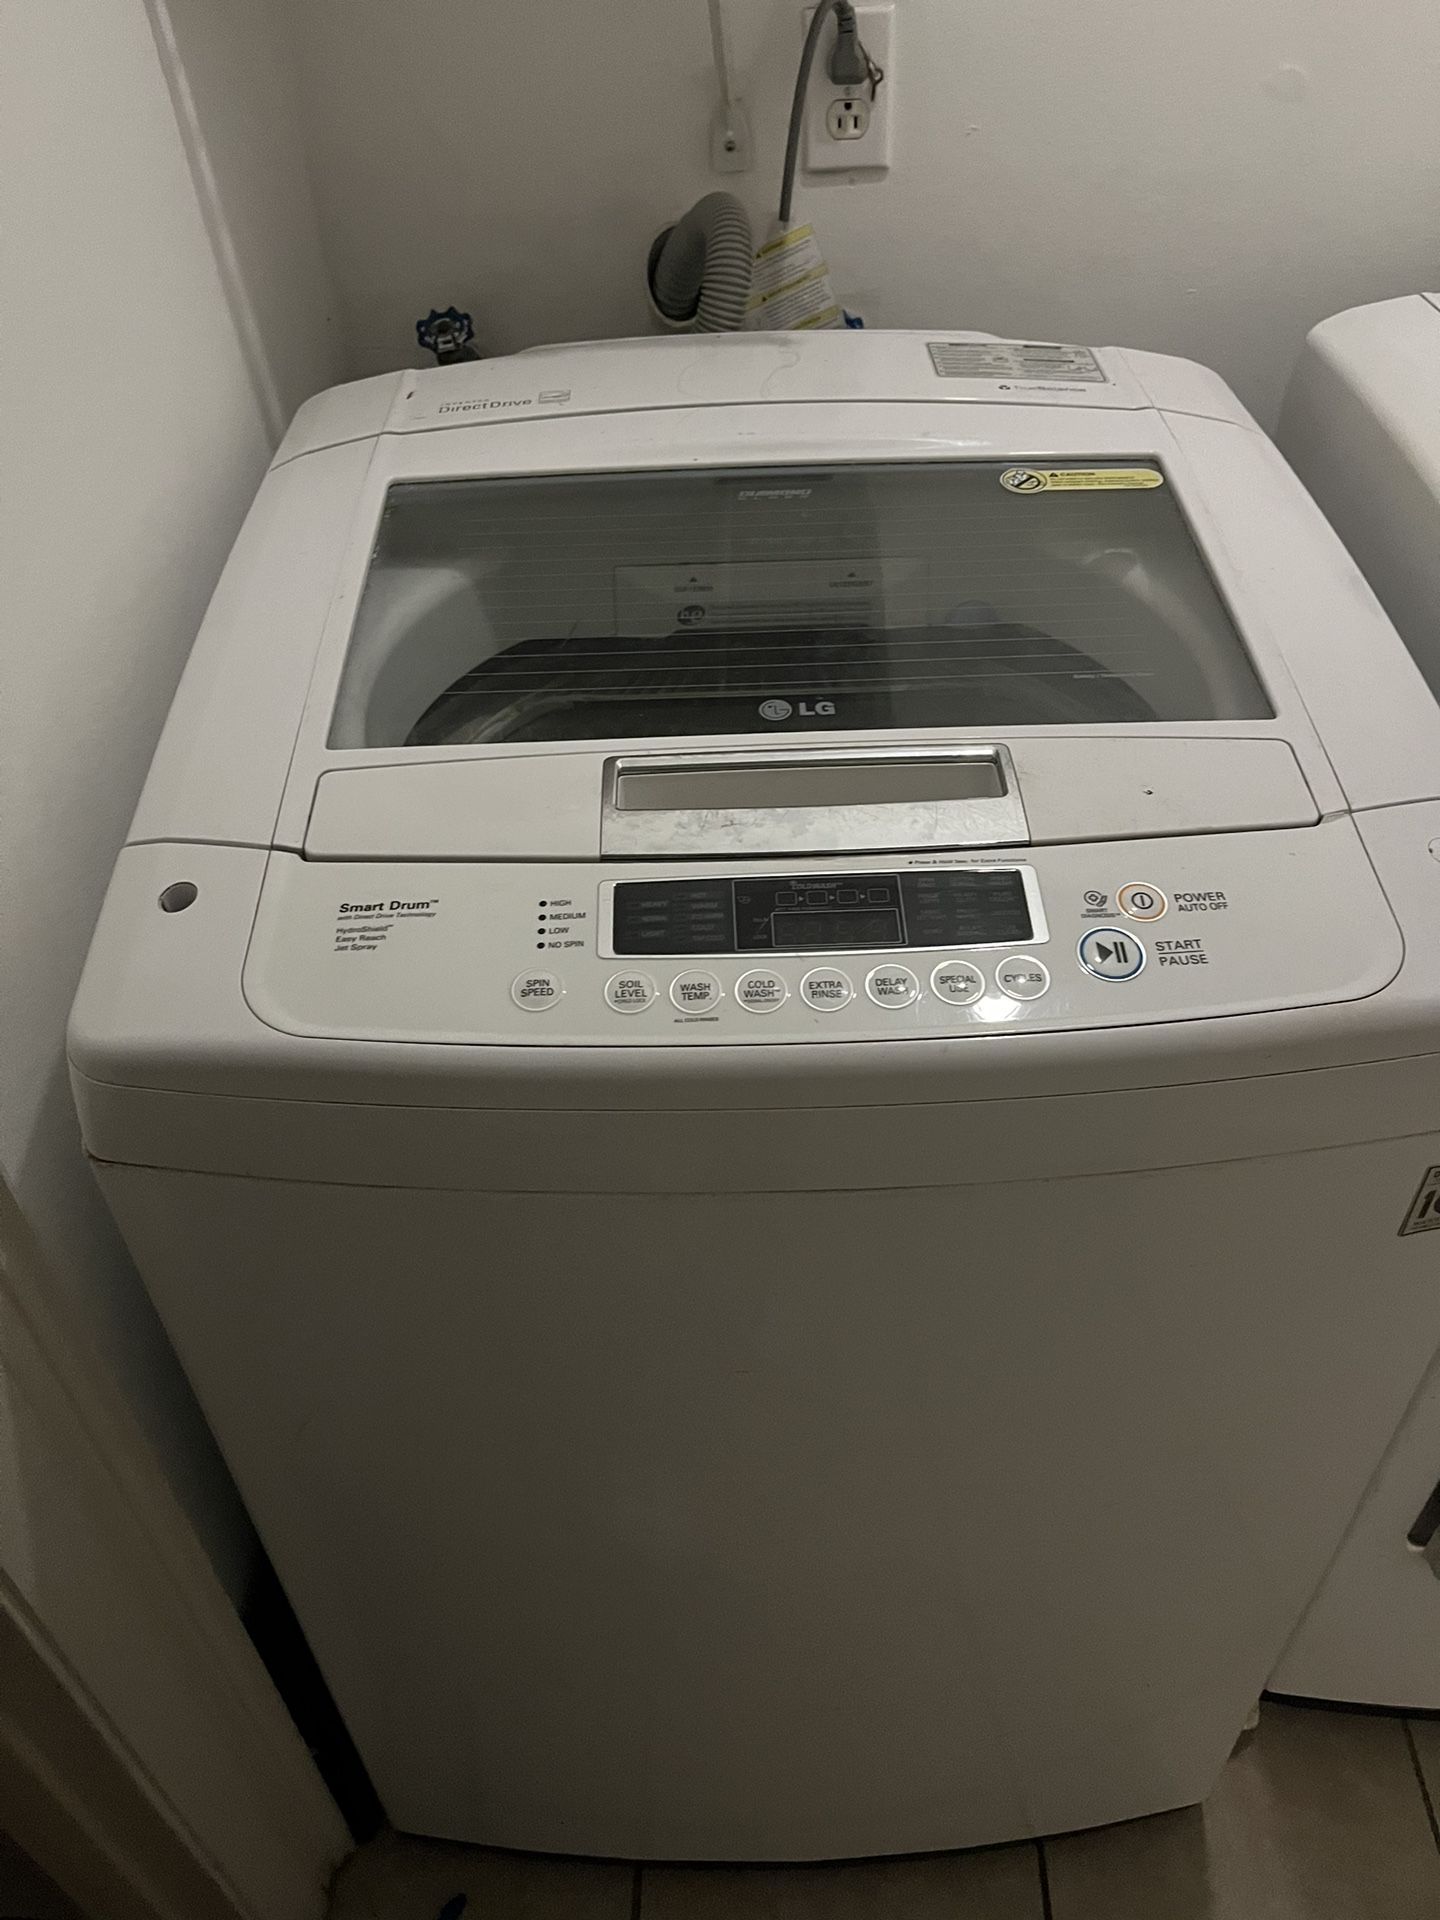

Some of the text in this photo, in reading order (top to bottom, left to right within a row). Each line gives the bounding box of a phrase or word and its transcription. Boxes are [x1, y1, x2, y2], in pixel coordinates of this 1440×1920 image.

[799, 701, 836, 716] LG
[1174, 891, 1226, 903] POWER
[339, 903, 385, 913] Smart
[1178, 902, 1229, 912] AUTO OFF
[549, 912, 586, 920] MEDIUM
[549, 927, 570, 935] LOW
[350, 943, 378, 952] Spray
[548, 940, 585, 949] NO SPIN
[1155, 939, 1202, 951] START
[1159, 954, 1209, 966] PAUSE
[526, 979, 550, 988] SPIN
[875, 978, 907, 987] DELAY
[939, 975, 976, 984] SPECIAL
[618, 980, 643, 989] SOIL
[680, 982, 711, 992] WASH
[748, 980, 775, 989] COLD
[808, 981, 844, 990] EXTRA
[520, 988, 554, 998] SPEED
[614, 989, 648, 998] LEVEL
[681, 991, 712, 1001] TEMP.
[811, 989, 844, 999] RINSE
